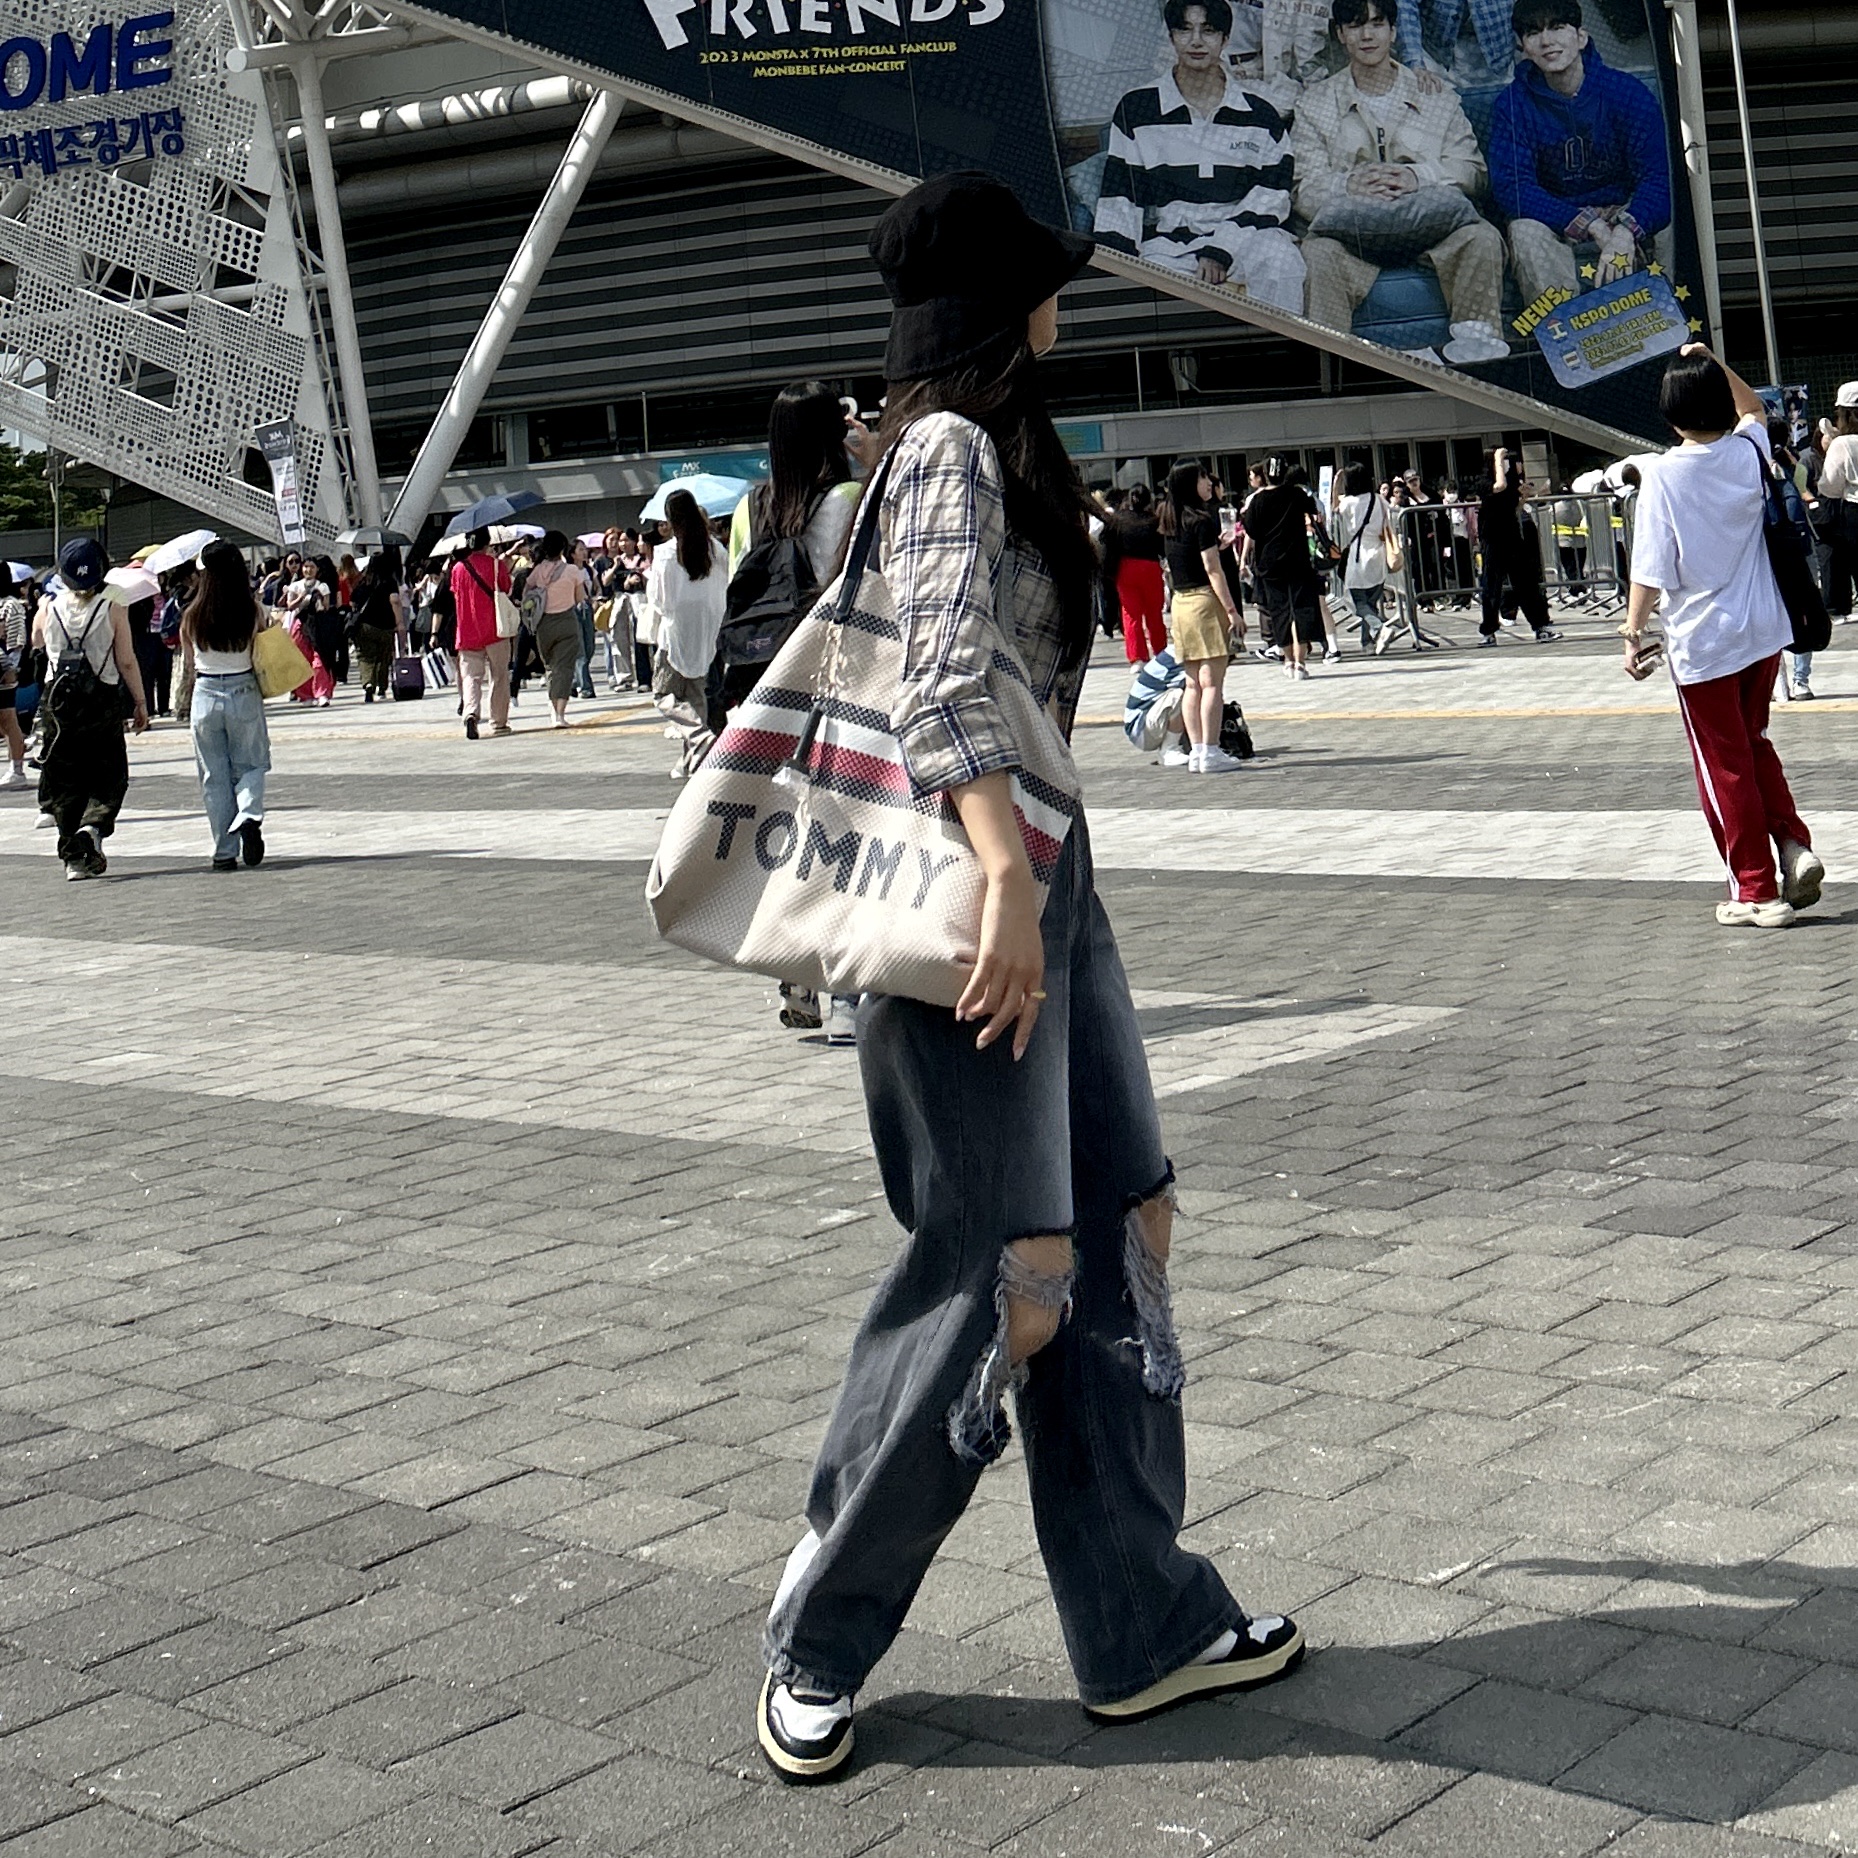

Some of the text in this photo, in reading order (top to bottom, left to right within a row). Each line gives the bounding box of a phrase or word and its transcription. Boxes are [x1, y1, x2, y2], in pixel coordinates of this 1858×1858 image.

[699, 50, 739, 65] 2023
[741, 48, 799, 62] MONSTA
[811, 46, 840, 60] 7TH
[841, 44, 897, 58] OFFICIAL
[900, 41, 957, 54] FANCLUB
[753, 60, 907, 78] MONBEBE FAN-CONCERT
[1511, 285, 1564, 337] NEWS
[1569, 287, 1653, 331] KSPO DOME
[706, 800, 960, 910] TOMMY
